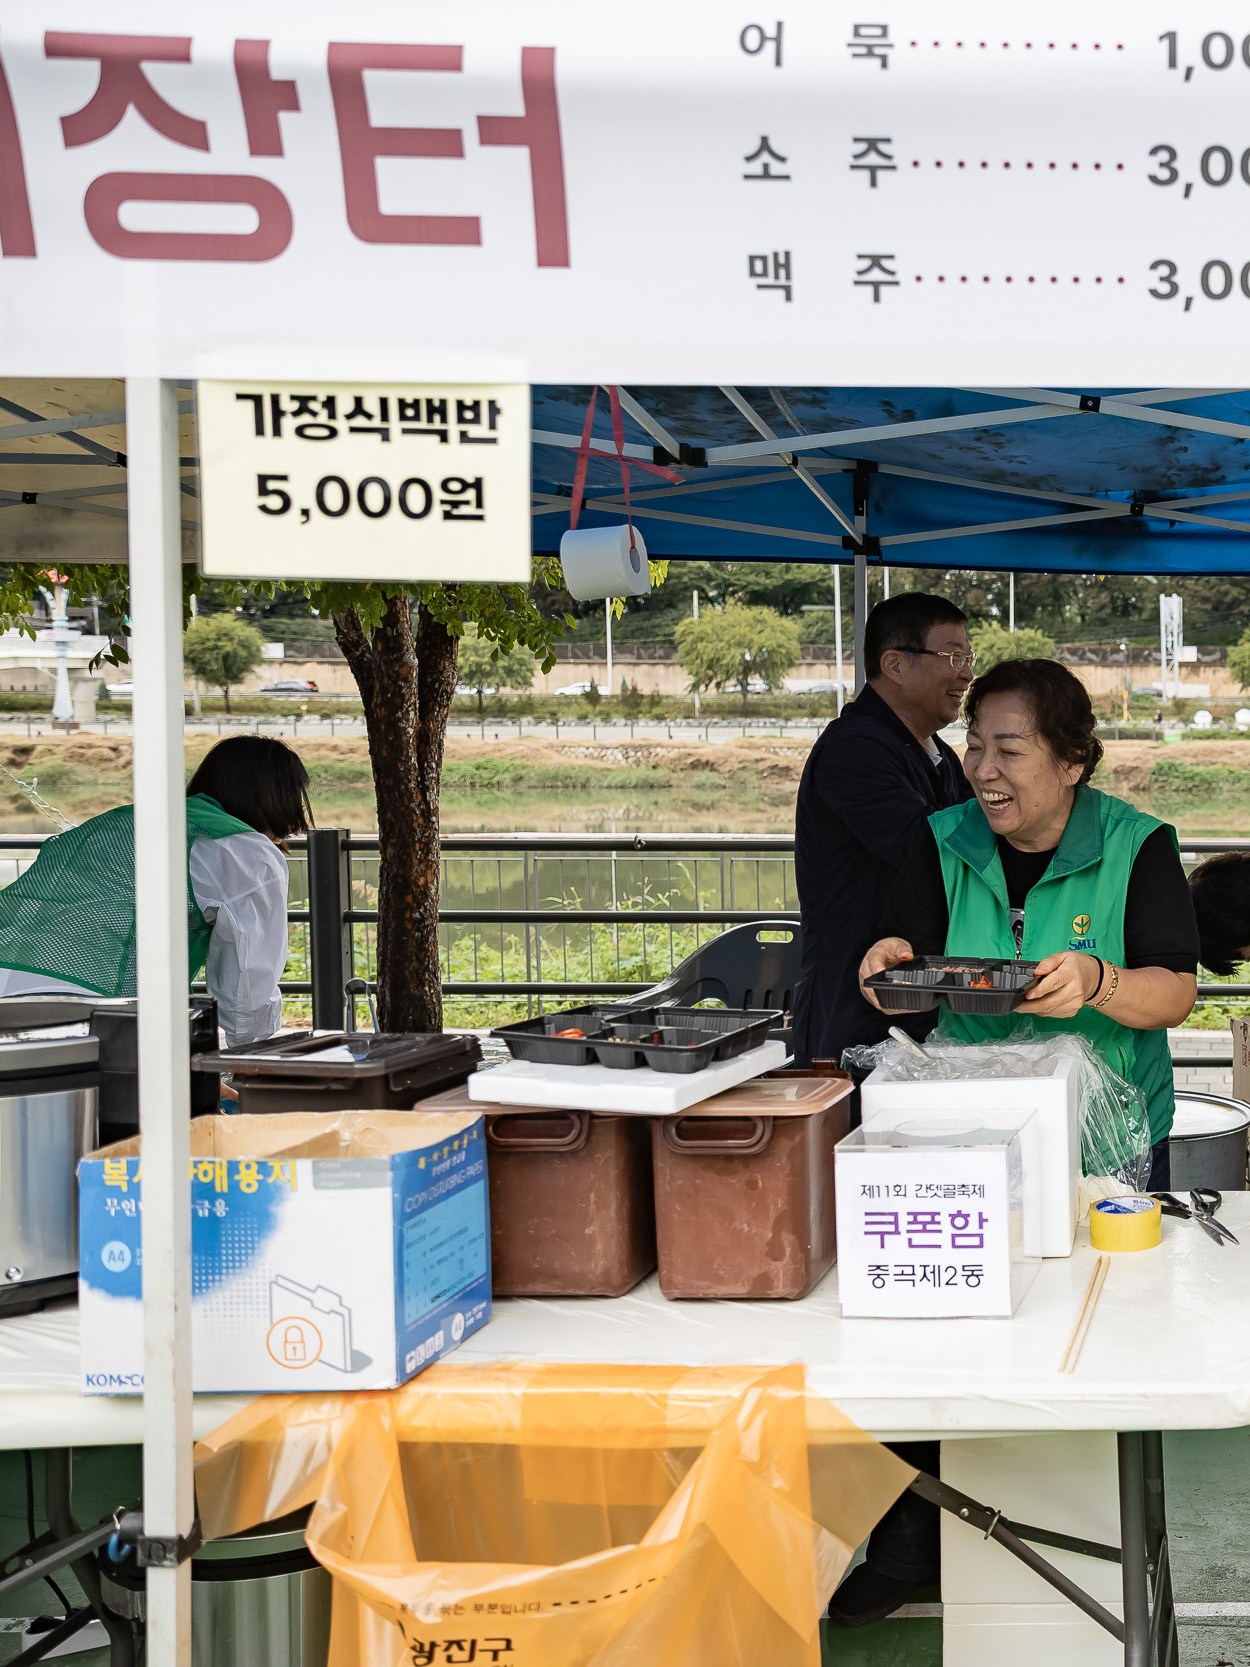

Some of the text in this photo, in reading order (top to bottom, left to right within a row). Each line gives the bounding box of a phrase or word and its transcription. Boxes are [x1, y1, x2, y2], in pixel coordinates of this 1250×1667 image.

[740, 21, 786, 69] 어
[846, 23, 895, 71] 묵
[0, 29, 572, 270] 장터
[743, 136, 792, 184] 소
[849, 137, 898, 189] 주
[748, 250, 794, 303] 맥
[853, 253, 901, 304] 주
[235, 392, 503, 447] 가정식백반
[257, 473, 487, 526] 5,000원
[1068, 938, 1097, 951] SMU
[861, 1184, 907, 1199] 제11회
[864, 1209, 990, 1250] 쿠폰함
[107, 1250, 126, 1263] A4
[867, 1264, 985, 1290] 중곡제2동
[410, 1637, 515, 1667] 광진구
